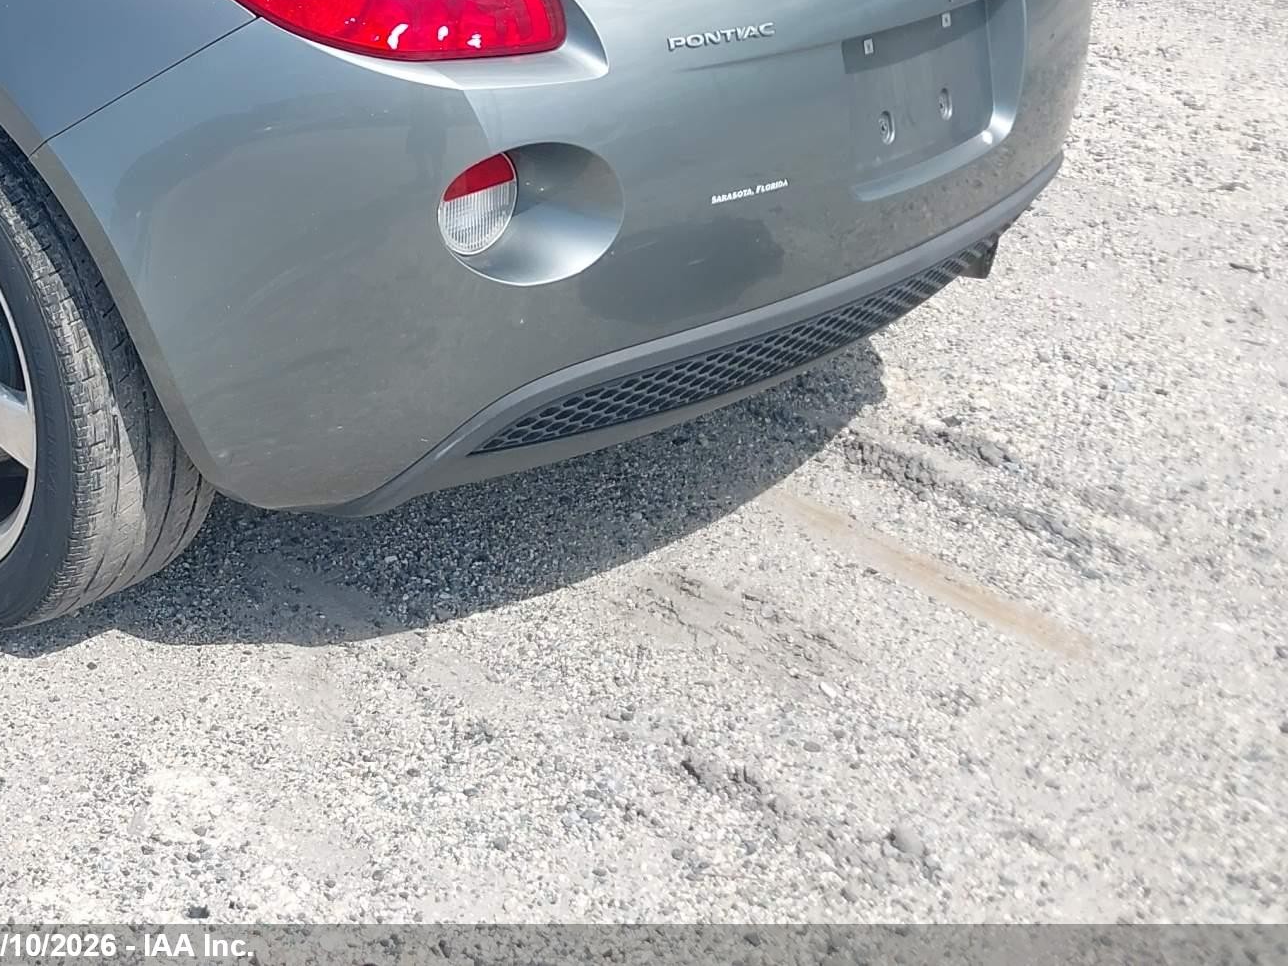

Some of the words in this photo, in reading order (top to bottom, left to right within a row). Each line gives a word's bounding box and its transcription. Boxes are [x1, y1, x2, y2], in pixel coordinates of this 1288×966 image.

[668, 22, 775, 51] PONTIAC
[712, 188, 755, 205] SARASOTA,
[756, 179, 789, 194] FLORIDA
